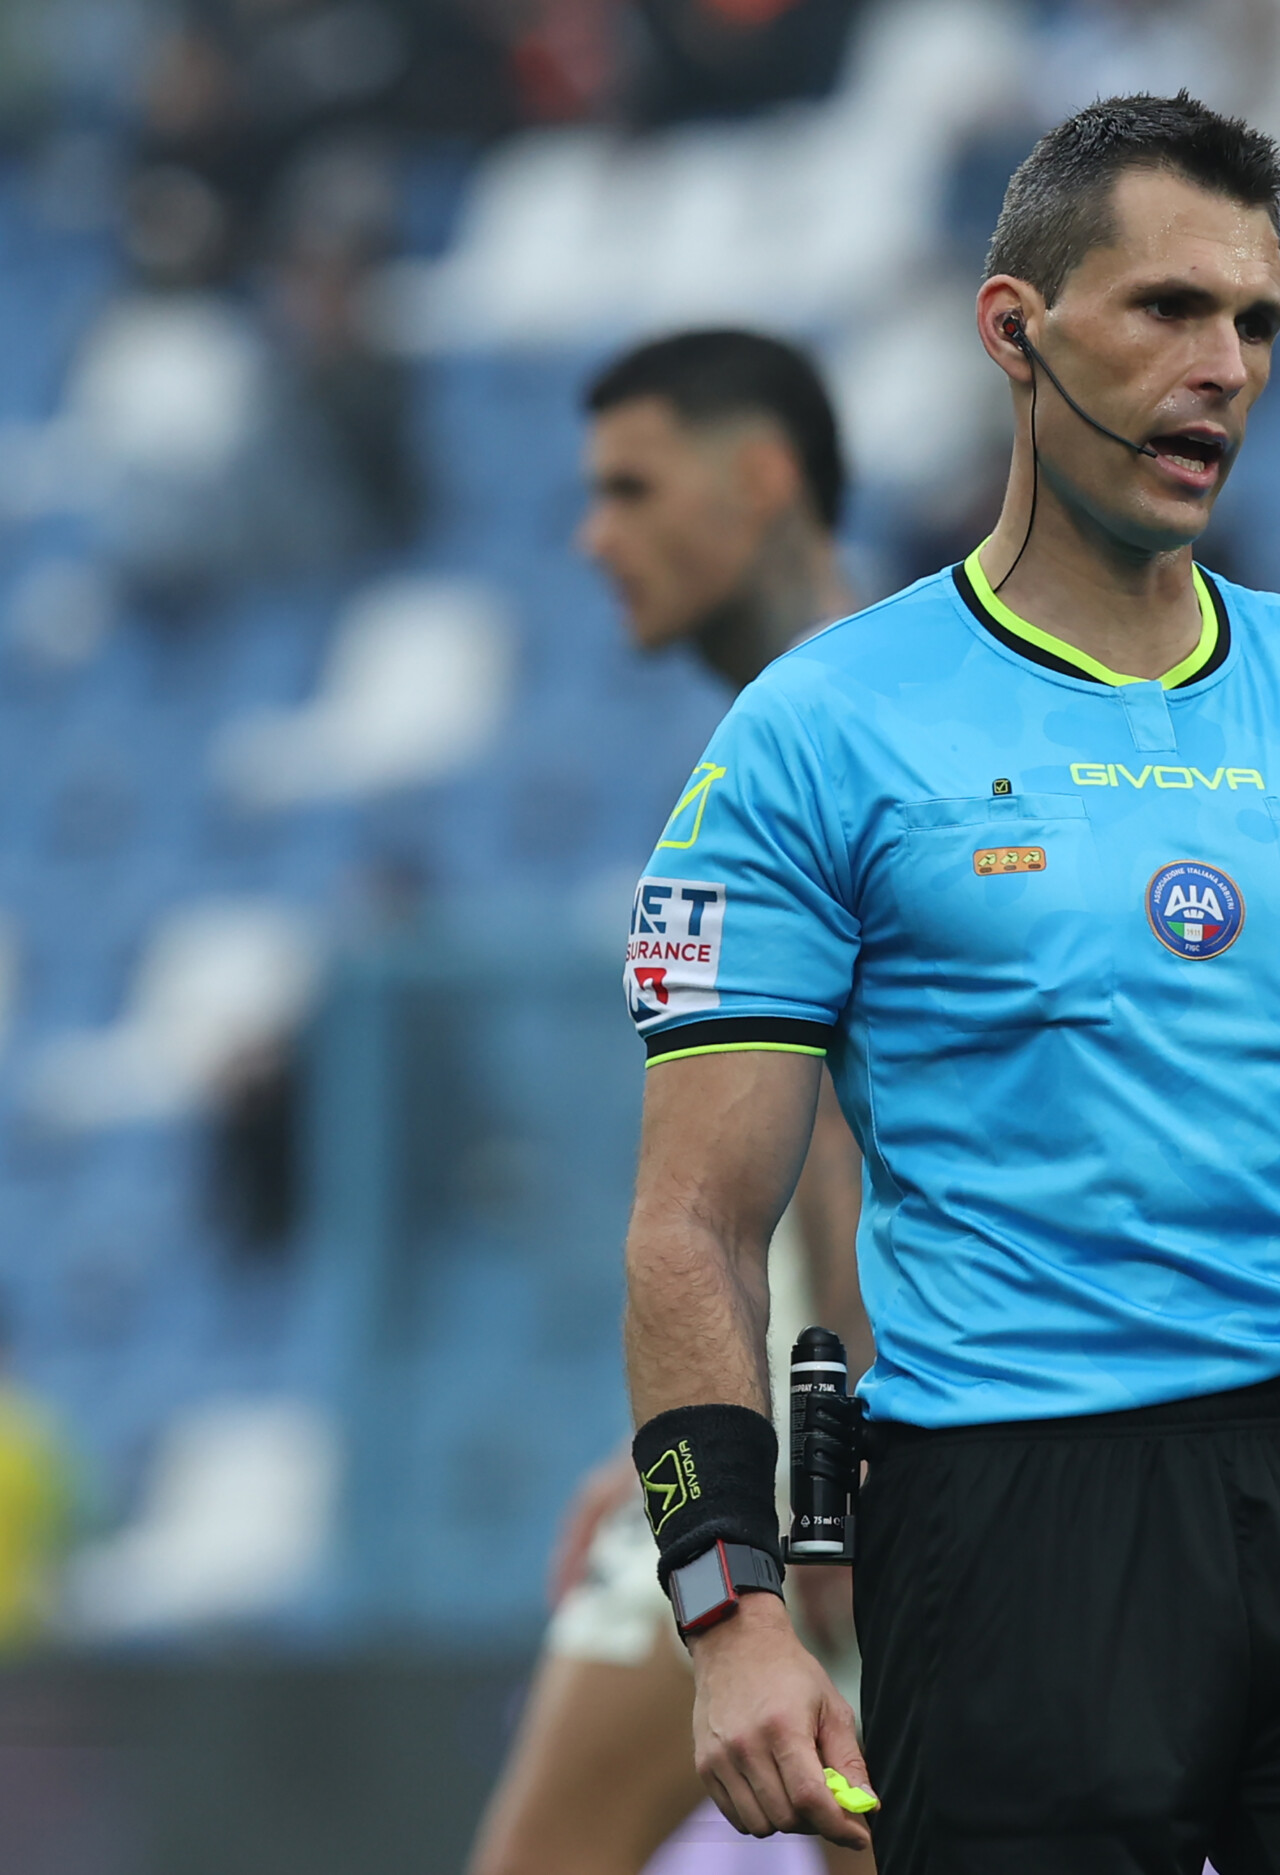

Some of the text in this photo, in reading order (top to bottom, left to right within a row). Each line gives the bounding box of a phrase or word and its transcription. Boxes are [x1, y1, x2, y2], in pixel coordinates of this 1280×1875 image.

[1070, 763, 1265, 790] GIVOVA
[1187, 867, 1218, 884] ITALIANA
[1164, 885, 1224, 921] AIA
[679, 1439, 701, 1499] GIVOVA
